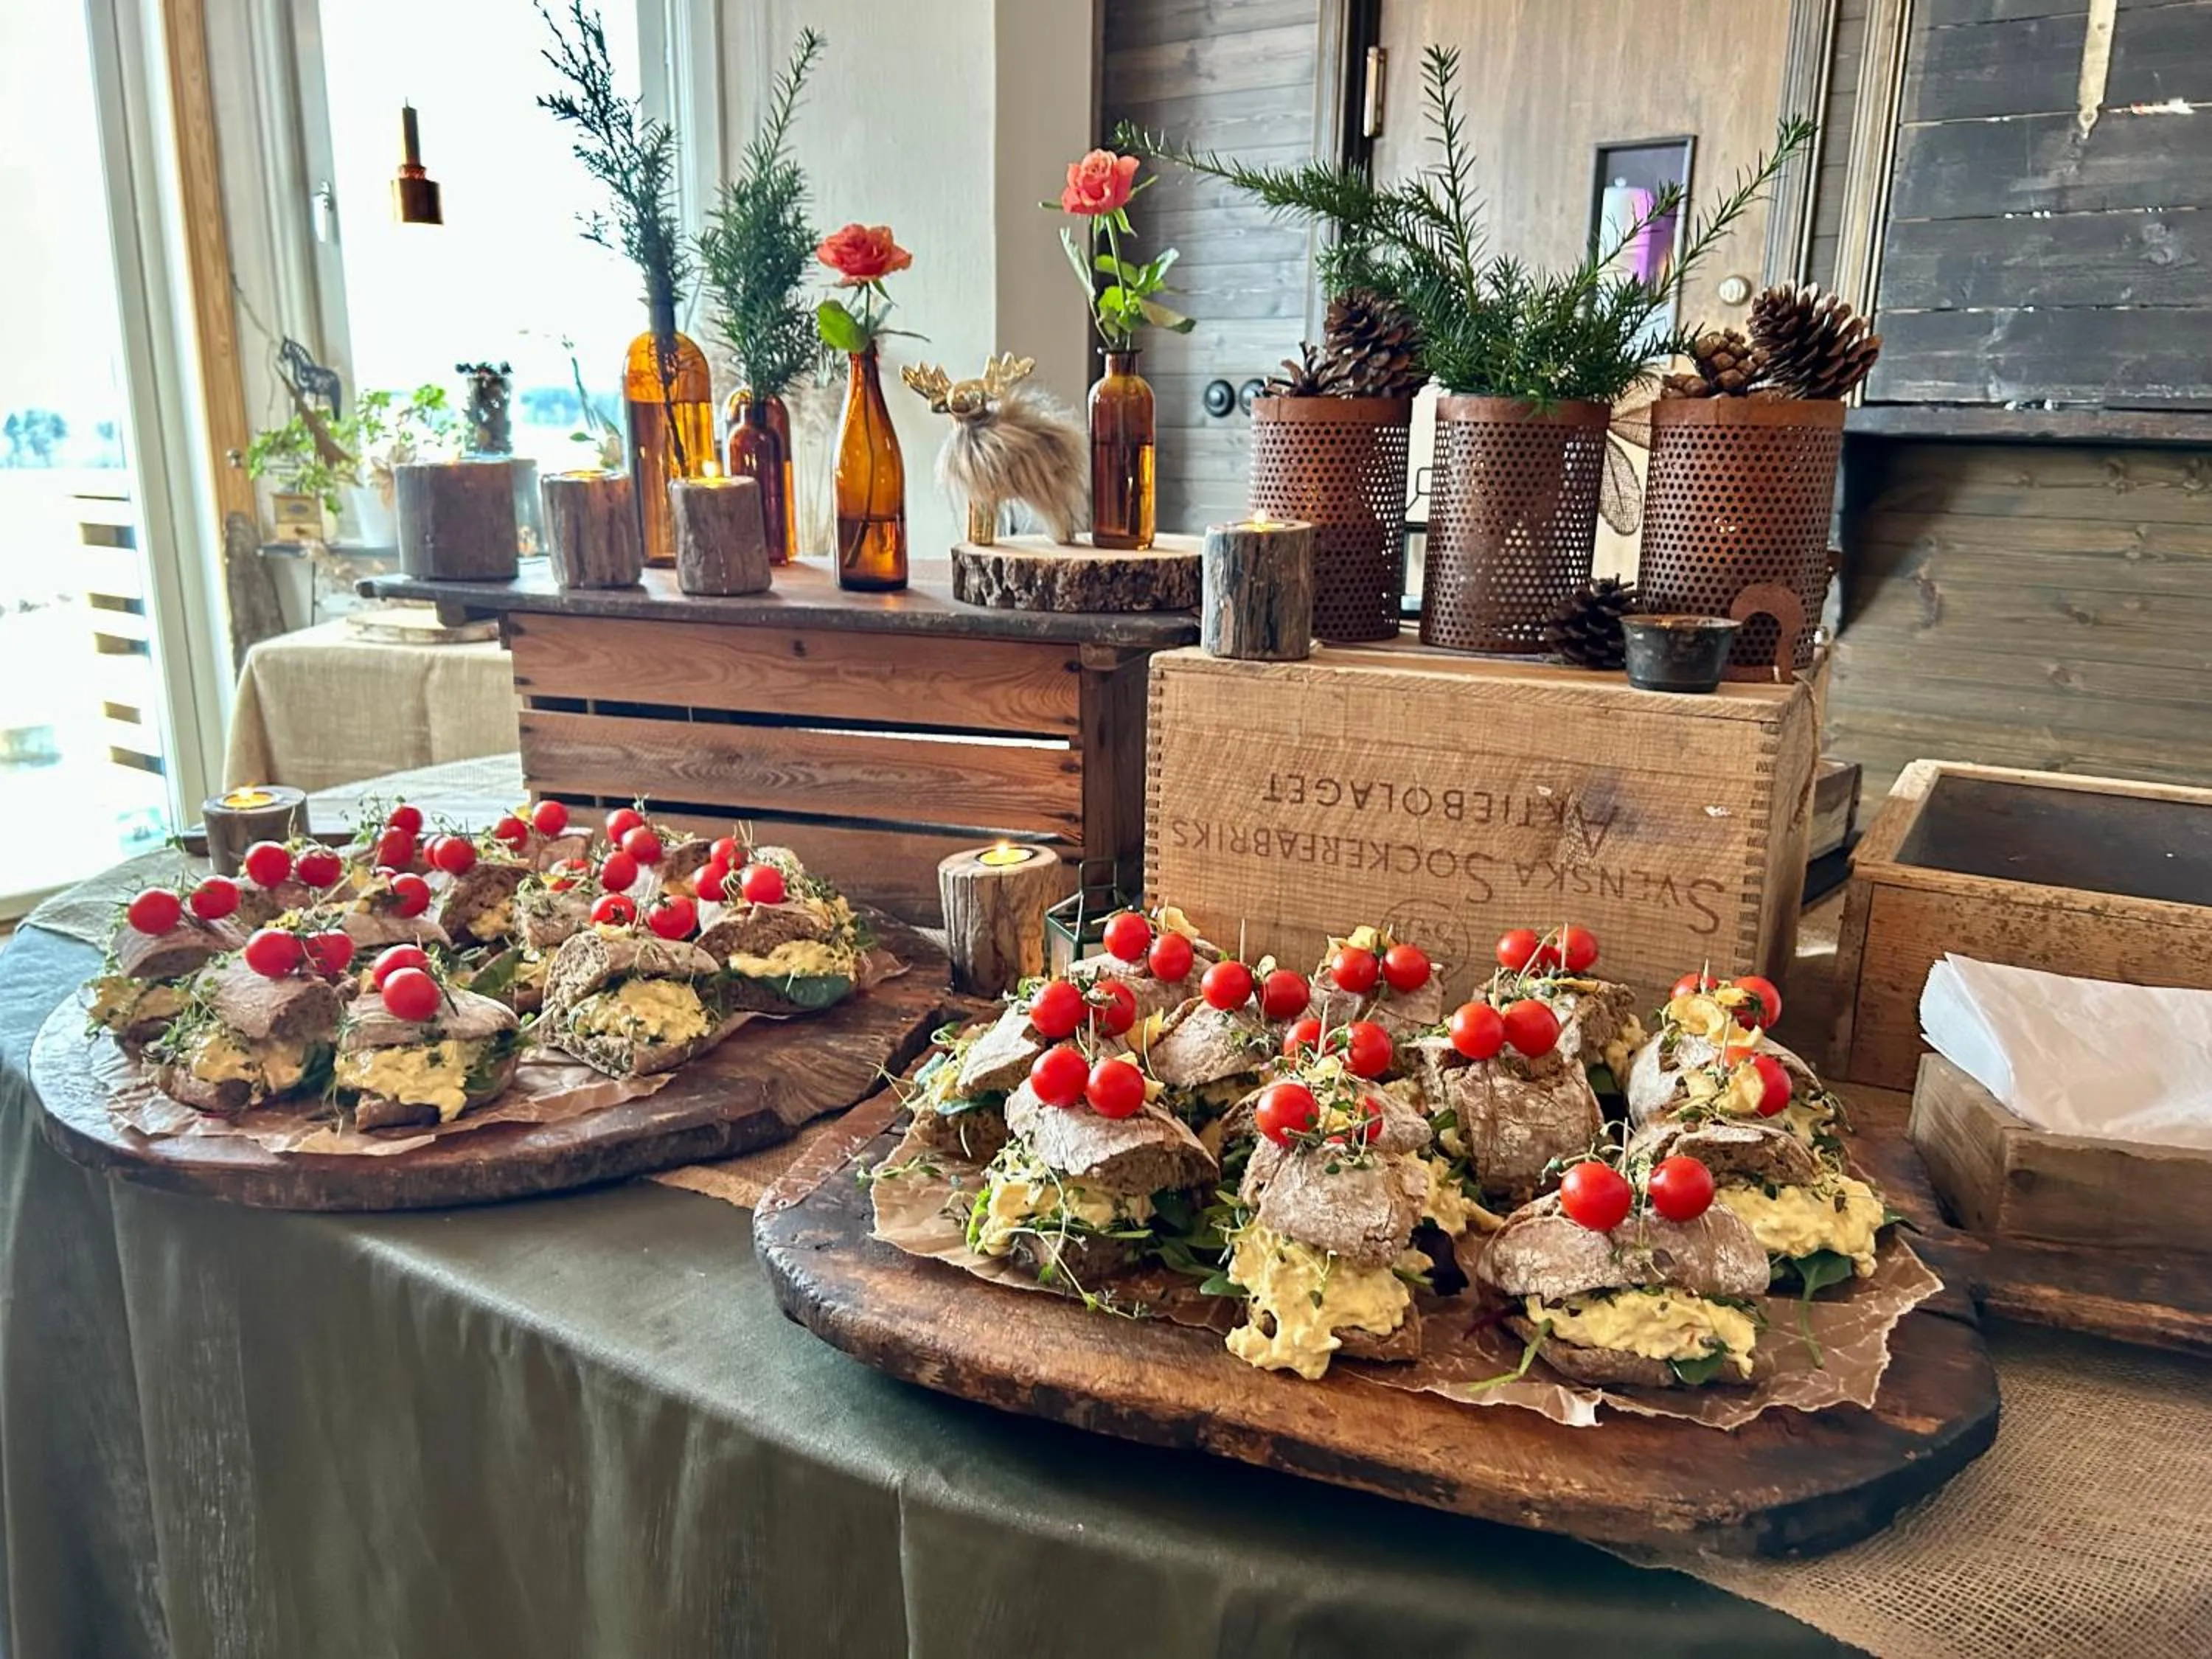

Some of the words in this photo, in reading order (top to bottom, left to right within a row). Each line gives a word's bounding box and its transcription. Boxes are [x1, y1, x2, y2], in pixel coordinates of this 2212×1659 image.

[1262, 772, 1619, 858] AKTIEBOLAGET
[1171, 818, 1493, 904] SOCKERFABRIKS
[1512, 857, 1725, 934] SVENSKA
